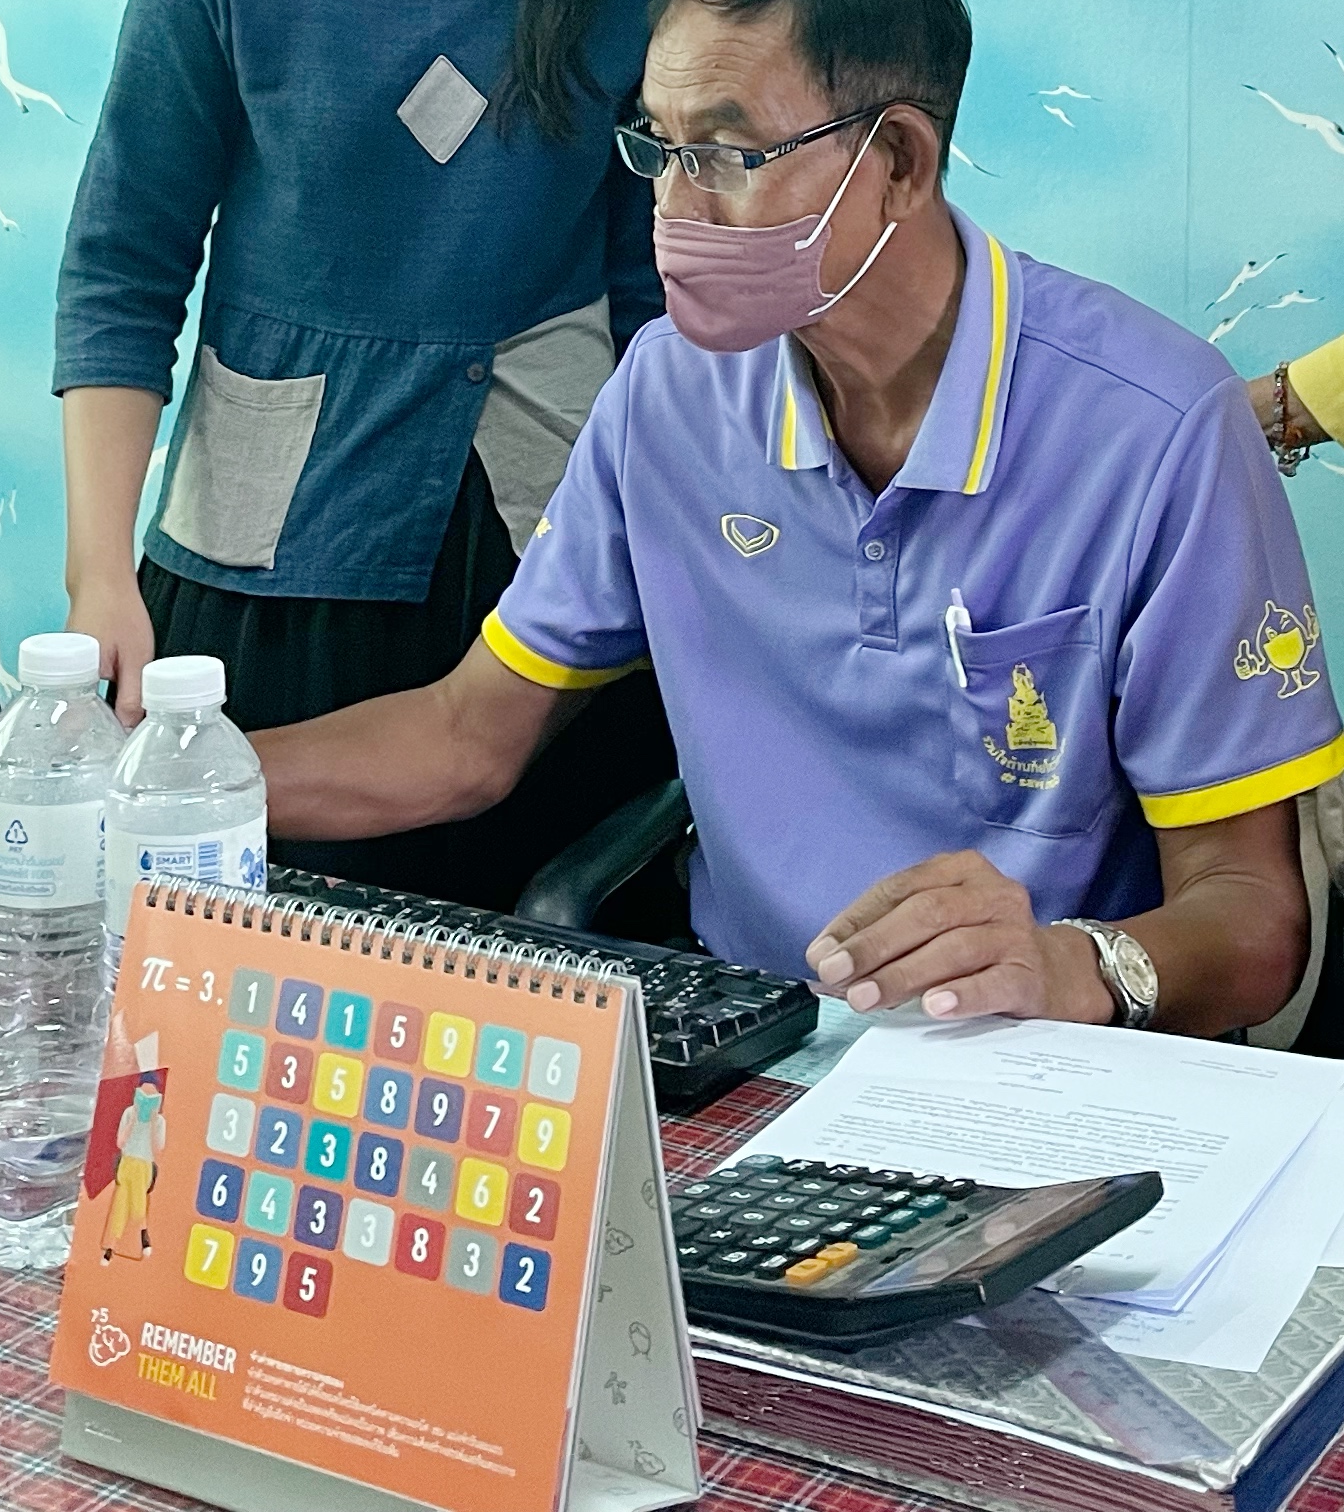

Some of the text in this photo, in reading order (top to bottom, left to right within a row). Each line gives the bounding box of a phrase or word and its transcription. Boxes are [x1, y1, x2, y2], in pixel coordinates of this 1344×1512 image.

[156, 856, 191, 865] SMART
[247, 981, 258, 1013] 1
[291, 992, 308, 1025] 4
[343, 1004, 354, 1036] 1
[390, 1015, 407, 1048] 5
[442, 1027, 459, 1060] 9
[491, 1039, 510, 1074] 2
[546, 1052, 562, 1085] 6
[233, 1044, 554, 1153] 5 3 5 8 9 7 9
[222, 1108, 544, 1223] 3 2 3 8 4 6 2
[201, 1238, 318, 1302] 7 9 5
[212, 1174, 535, 1294] 6 4 3 3 8 3 2
[137, 1352, 217, 1401] THEM ALL
[139, 1321, 237, 1374] REMEMBER
